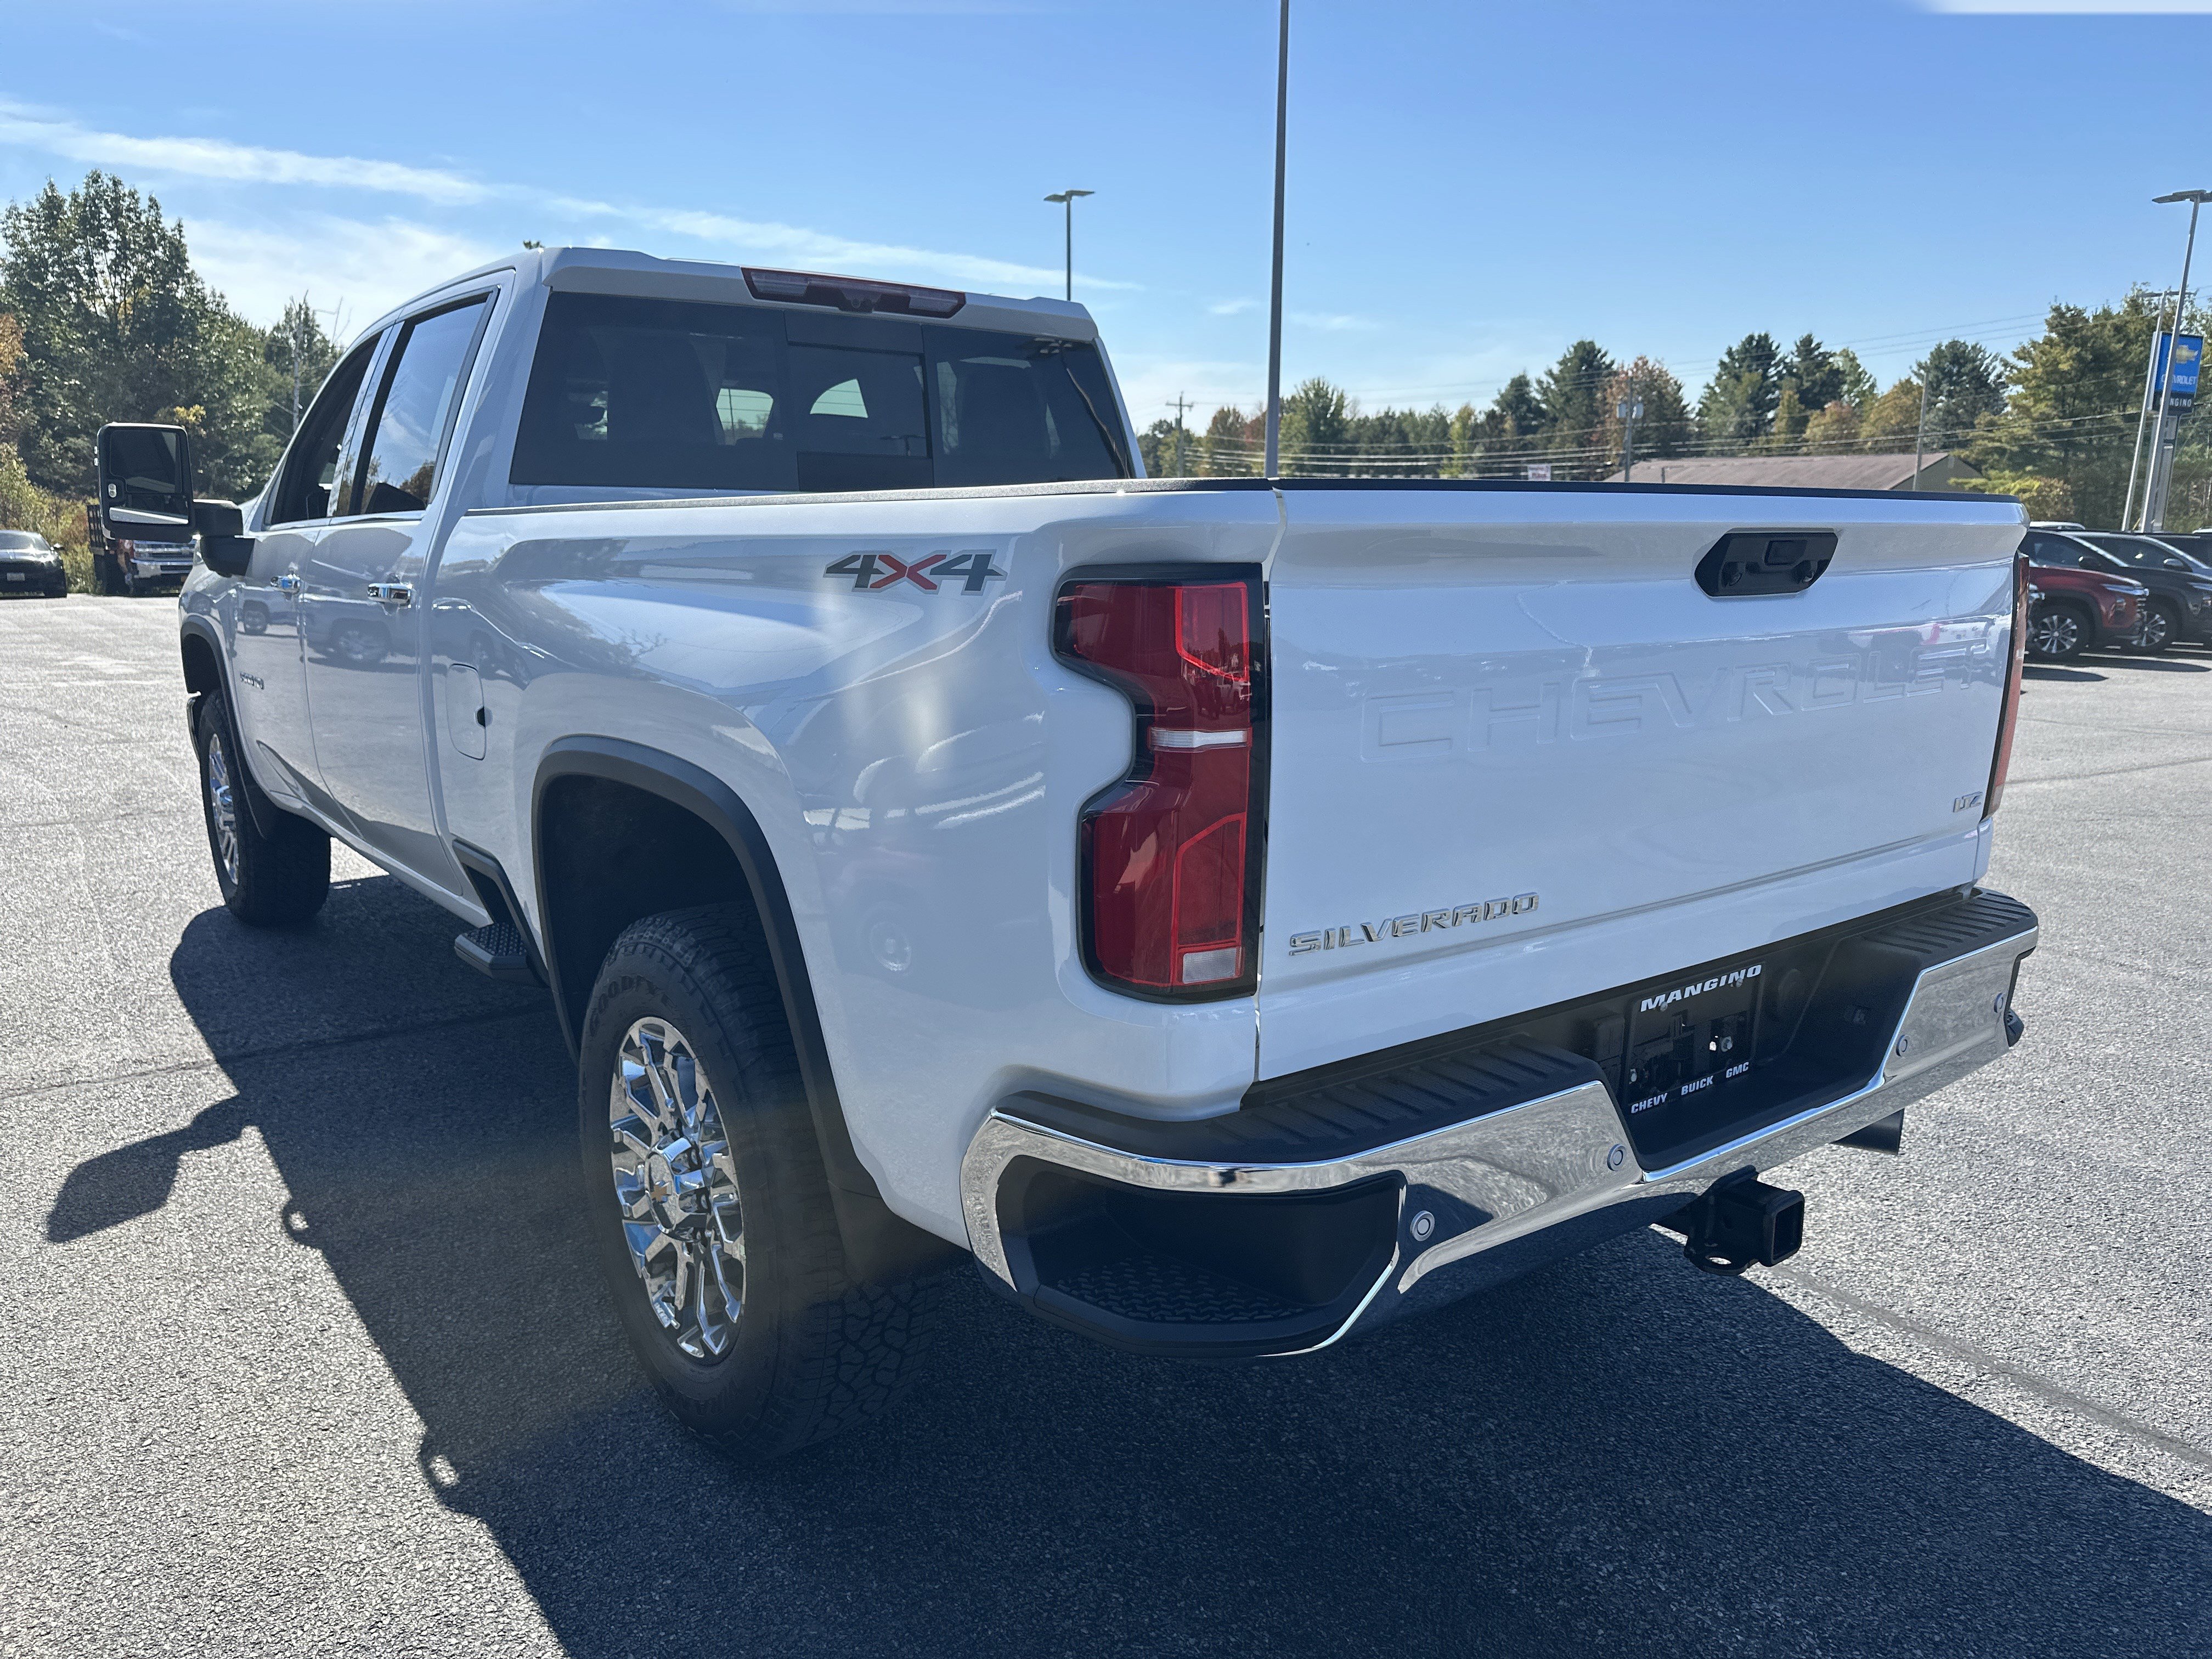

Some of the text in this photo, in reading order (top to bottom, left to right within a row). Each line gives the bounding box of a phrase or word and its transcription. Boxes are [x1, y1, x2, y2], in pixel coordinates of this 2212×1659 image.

[2160, 397, 2192, 407] NGINO
[1361, 637, 1988, 763] CHEVROLET
[1953, 791, 1983, 812] LTZ
[1288, 892, 1539, 956] SILVERADO
[1640, 964, 1762, 1012] MANGINO
[1630, 1062, 1749, 1114] CHEVY BUICK GMC
